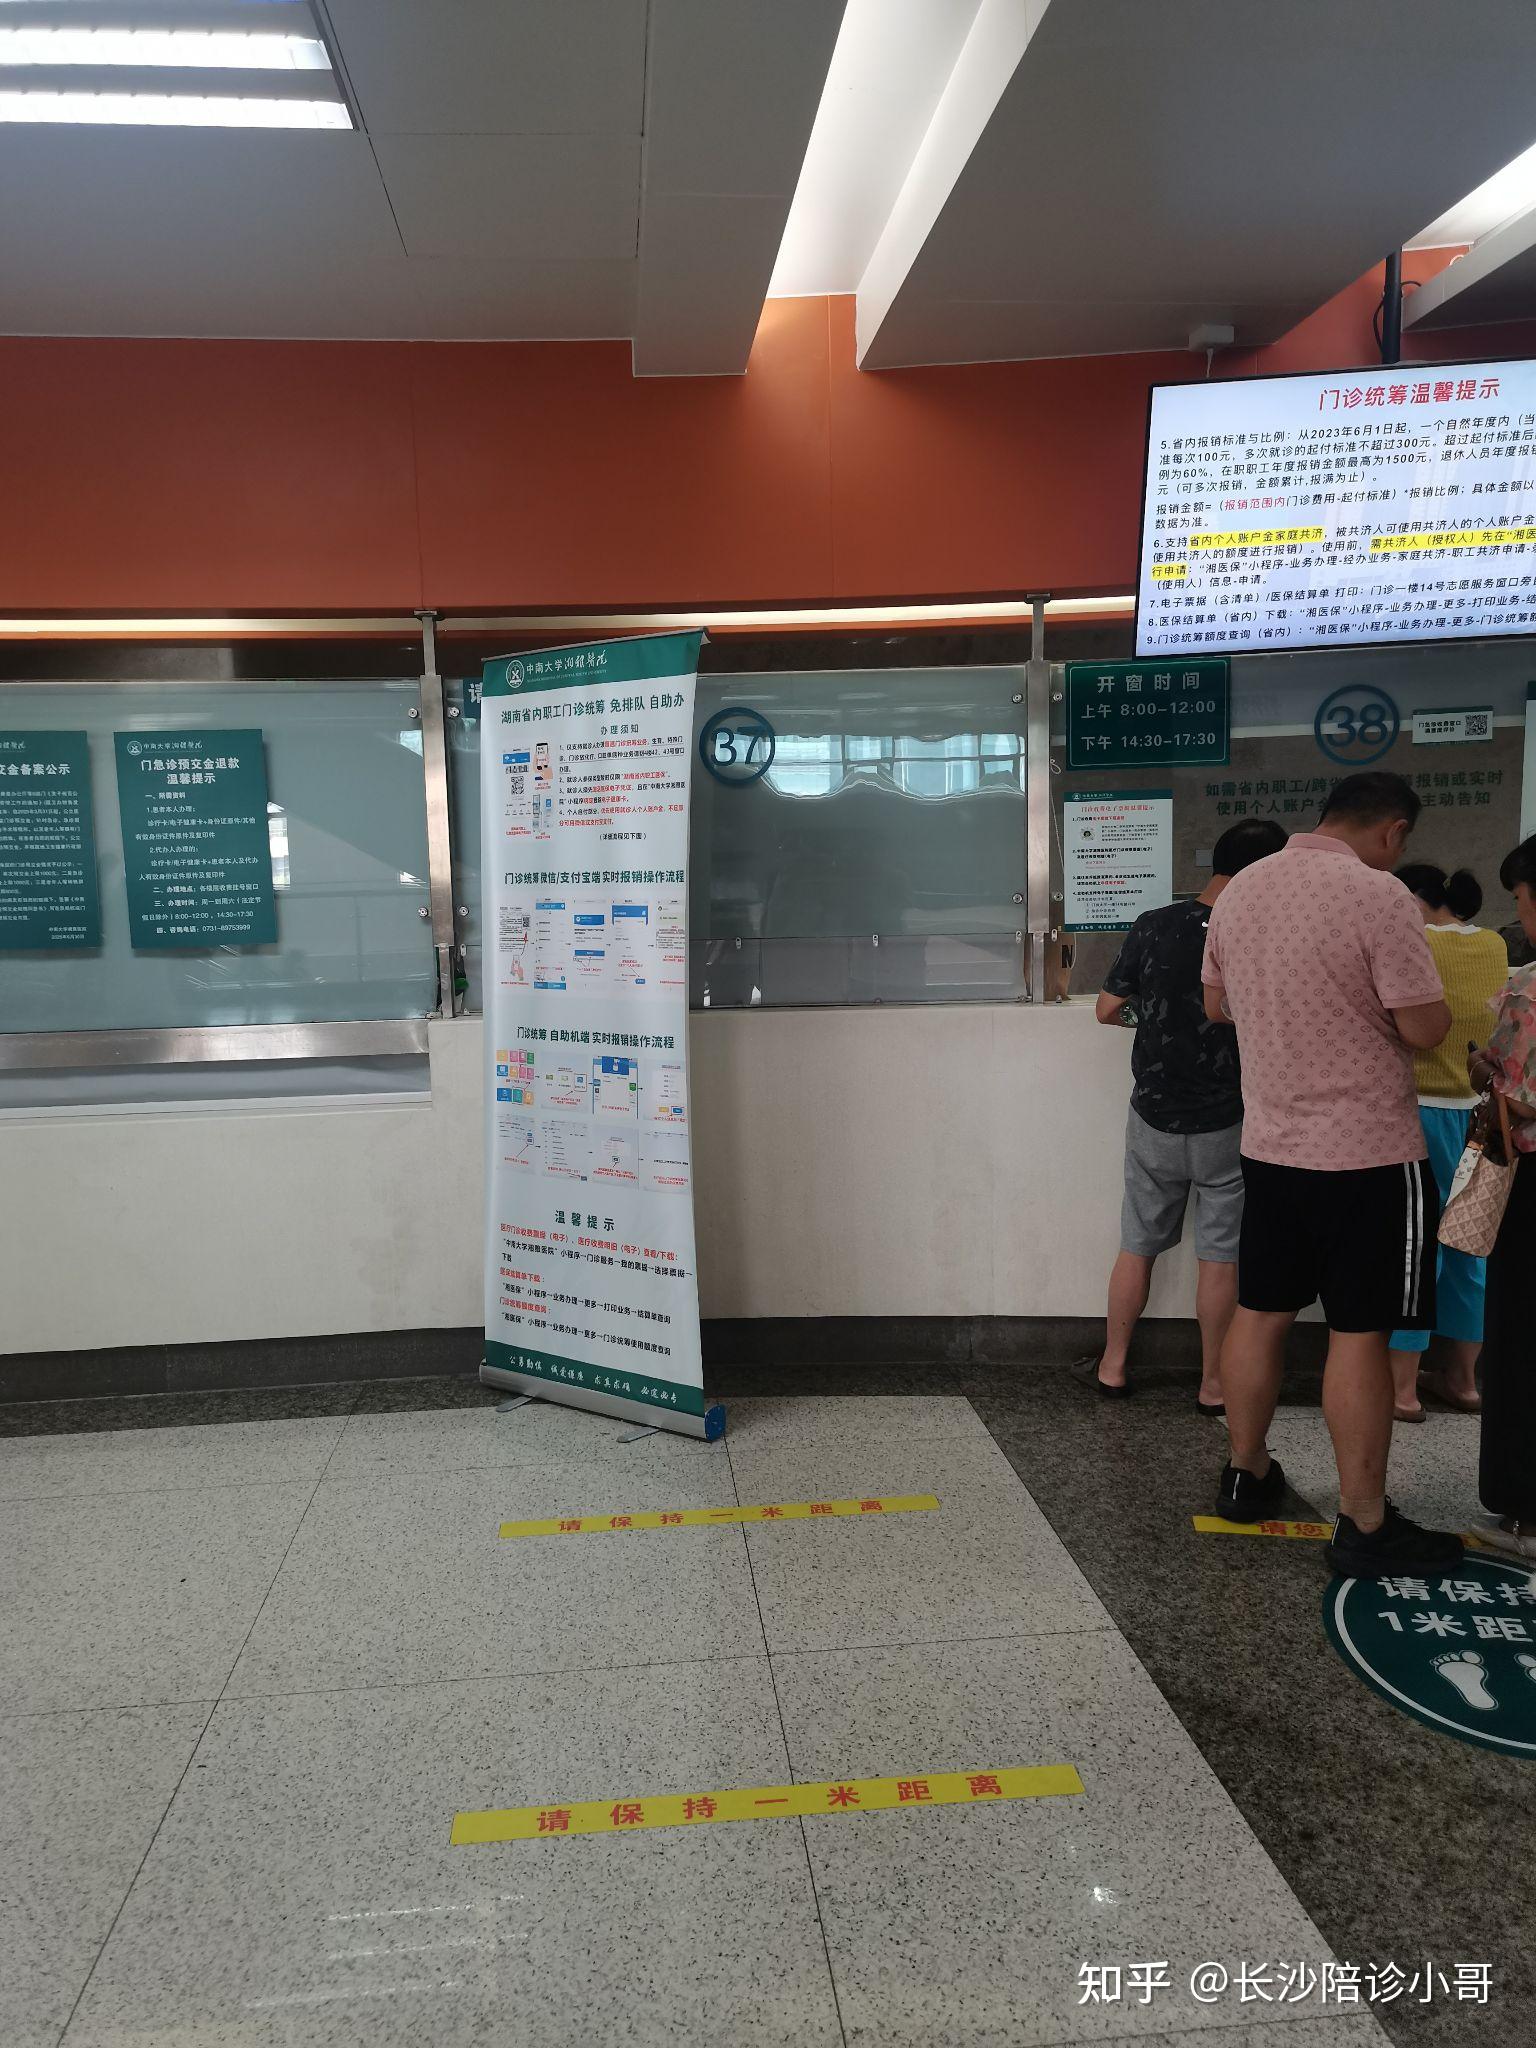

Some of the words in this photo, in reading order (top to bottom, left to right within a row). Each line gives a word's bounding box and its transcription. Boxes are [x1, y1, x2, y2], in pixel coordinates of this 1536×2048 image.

[1318, 378, 1501, 411] 门诊统筹温馨提示
[1159, 429, 1536, 466] 准每次100元，多次就诊的起付标准不超过300元。超过起付标准后
[1155, 517, 1210, 530] 数据为准。
[1334, 576, 1536, 598] 打印：门诊一楼14号志愿服务窗口旁
[1097, 672, 1200, 694] 开窗时间
[501, 699, 605, 725] 湖南省内职工门诊统筹
[610, 697, 645, 713] 免排队
[650, 692, 685, 710] 自助办
[1081, 704, 1112, 719] 上午
[1120, 701, 1216, 717] 8:00-12:00
[600, 724, 639, 735] 办理须知
[1326, 703, 1389, 748] 38
[710, 725, 767, 767] 37
[1081, 735, 1112, 750] 下午
[1120, 733, 1216, 749] 14:30-17:30
[140, 757, 241, 771] 门急诊预交金退款
[166, 773, 216, 785] 温馨提示
[517, 1026, 547, 1041] 门诊统筹
[550, 1029, 590, 1044] 自助机端
[592, 1032, 675, 1050] 实时报销操作流程
[555, 1209, 615, 1232] 温馨提示
[557, 1499, 884, 1532] 请保持一米距离
[1261, 1520, 1333, 1538] 请您
[1378, 1611, 1536, 1644] 1米距
[536, 1773, 1004, 1833] 请保持一米距离
